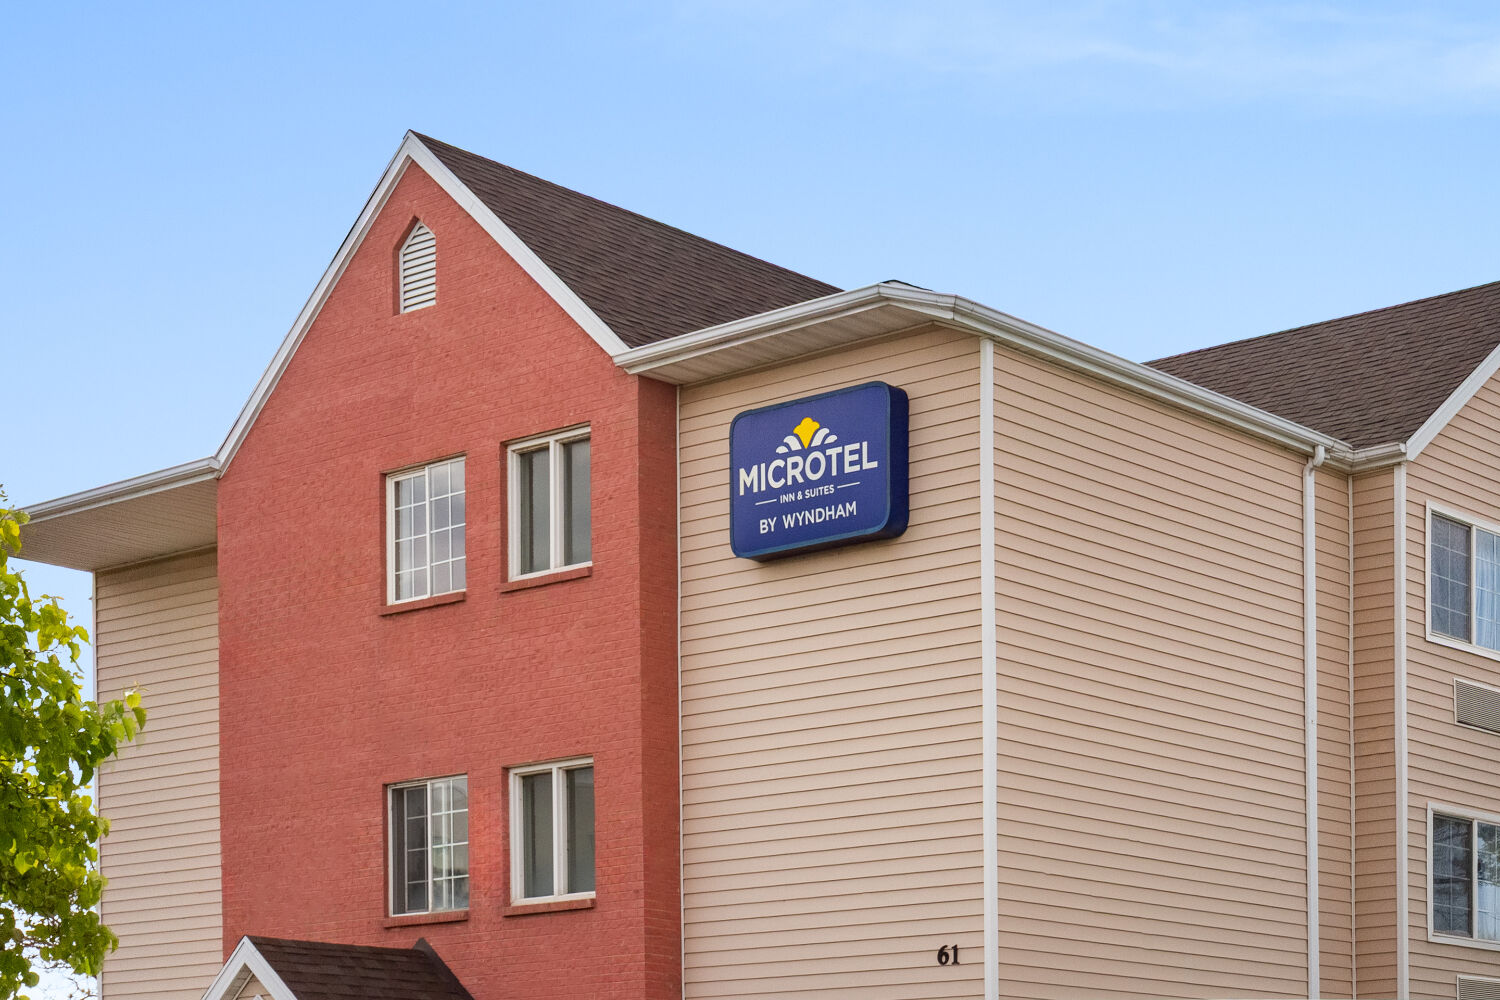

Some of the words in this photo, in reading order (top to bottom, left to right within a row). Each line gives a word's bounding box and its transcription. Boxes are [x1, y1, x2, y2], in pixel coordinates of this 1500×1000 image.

[739, 441, 878, 496] MICROTEL
[780, 491, 795, 504] INN
[797, 491, 803, 500] &
[805, 484, 835, 499] SUITES
[760, 516, 777, 534] BY
[782, 501, 857, 529] WYNDHAM
[937, 944, 960, 966] 61
